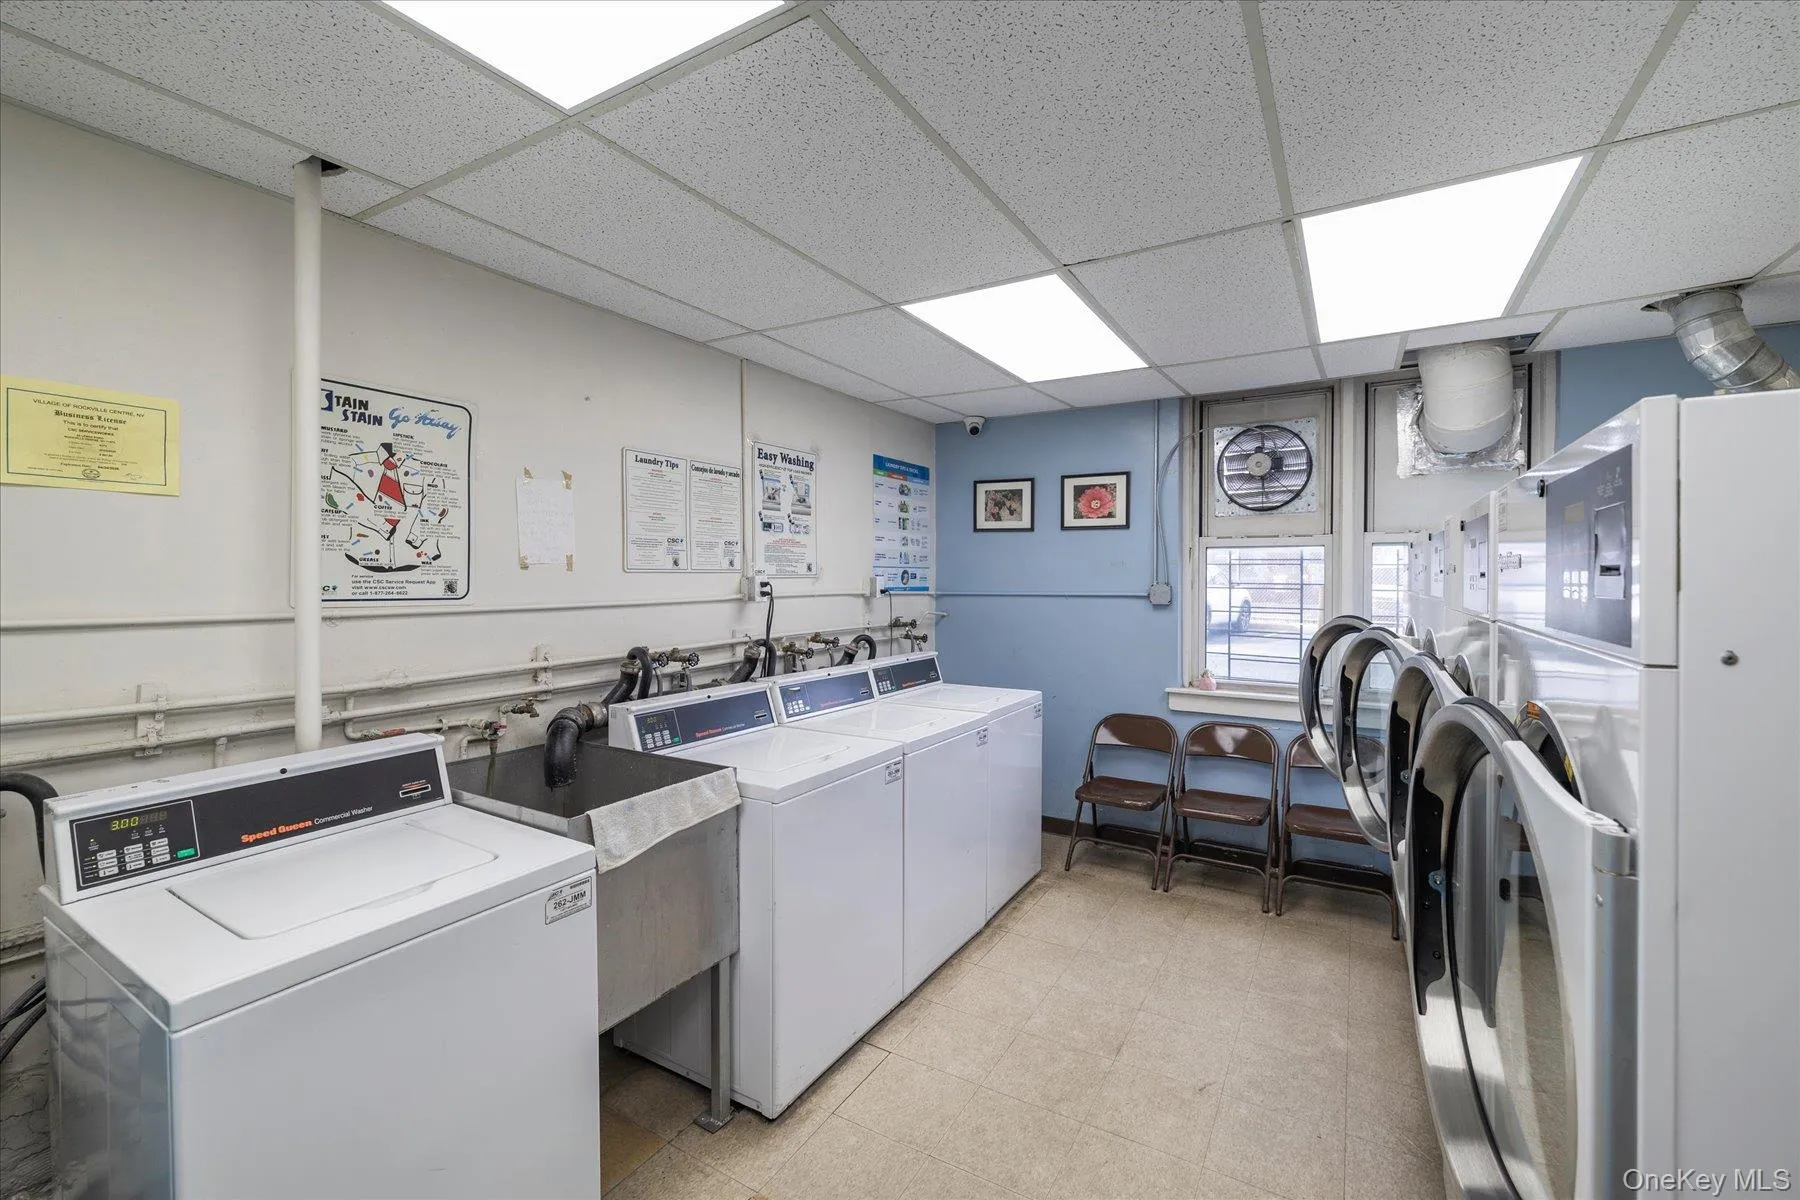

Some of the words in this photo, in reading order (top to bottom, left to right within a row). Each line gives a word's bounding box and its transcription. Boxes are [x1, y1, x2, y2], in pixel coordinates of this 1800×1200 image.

[33, 398, 61, 407] VILLAGE
[72, 404, 107, 413] ROCKVILLE
[54, 410, 94, 421] Business
[97, 415, 127, 424] License
[341, 410, 383, 427] STAIN
[388, 406, 412, 430] Go
[414, 408, 462, 440] Away
[320, 426, 348, 434] MUSTARD
[392, 432, 414, 440] LIPSTICK
[420, 460, 448, 468] CHOCOLATE
[634, 454, 664, 468] Laundry
[664, 459, 680, 470] Tips
[757, 448, 778, 465] Easy
[779, 452, 814, 472] Washing
[690, 464, 708, 474] Consejos
[240, 826, 278, 843] Speed
[278, 820, 312, 834] Queen
[314, 810, 350, 825] Commercial
[351, 806, 374, 816] Washer
[554, 890, 586, 910] 262-JMM
